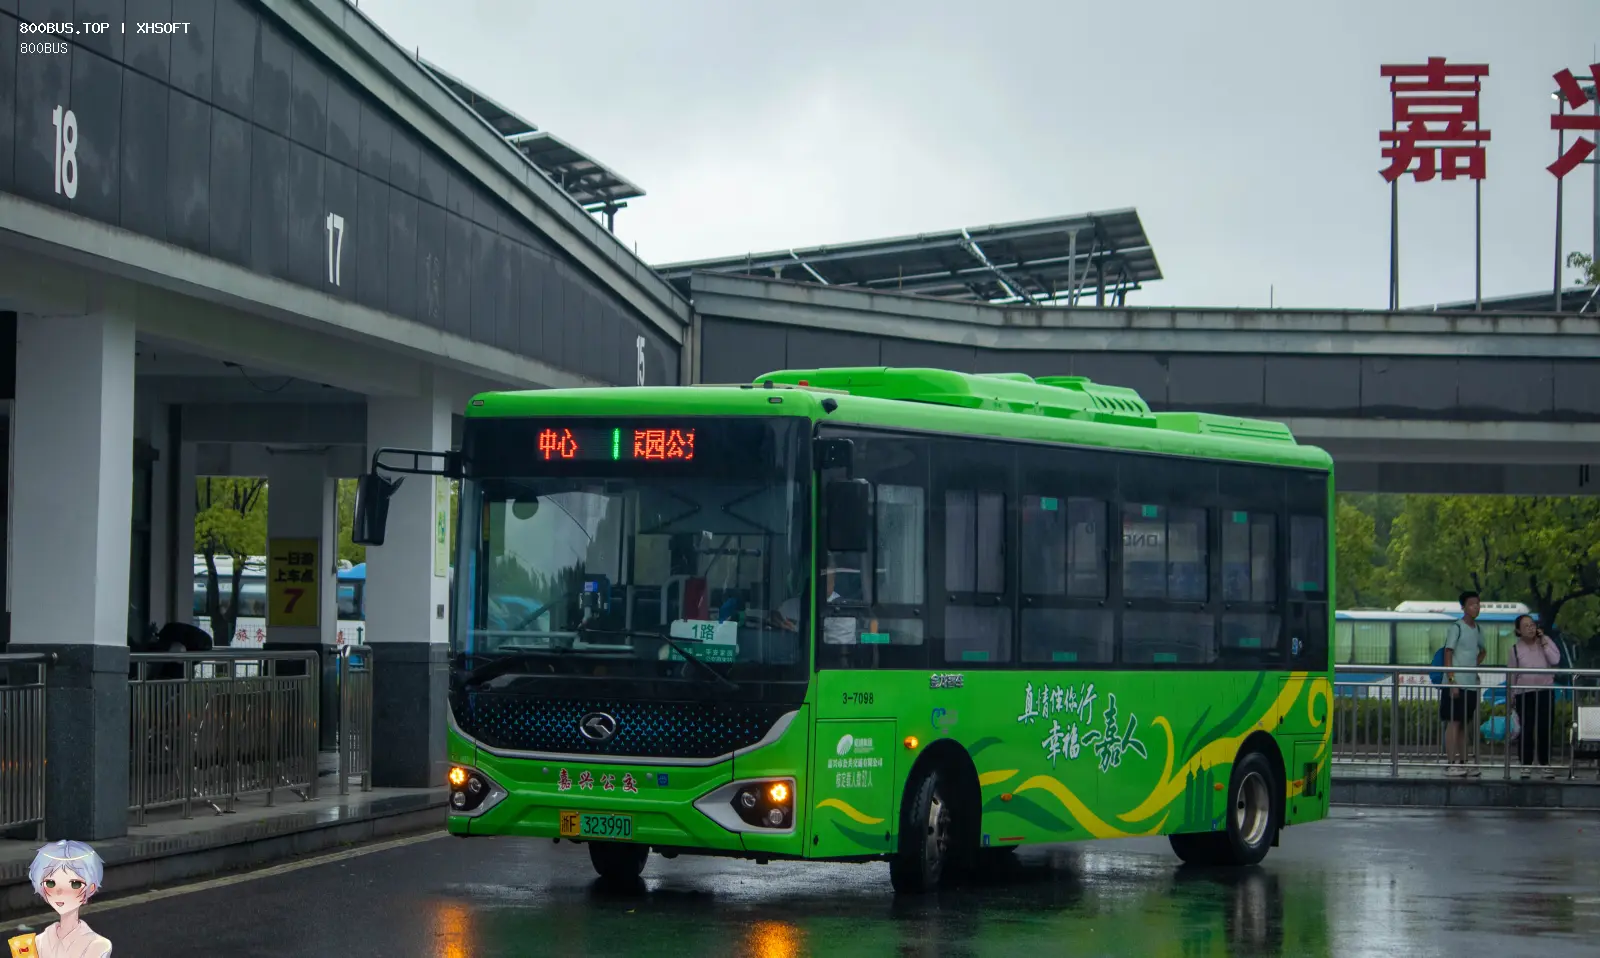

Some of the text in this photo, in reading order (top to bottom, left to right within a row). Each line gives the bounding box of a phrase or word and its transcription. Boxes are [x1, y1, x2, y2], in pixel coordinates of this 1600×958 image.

[52, 104, 78, 199] 18
[326, 212, 344, 286] 17
[636, 335, 645, 387] 15
[538, 428, 578, 460] 中心
[274, 569, 314, 583] 上车点
[284, 588, 304, 614] 7
[692, 624, 715, 641] 1路
[842, 692, 874, 705] 3-7098
[558, 768, 638, 794] 嘉兴公交
[583, 816, 631, 837] 32399D
